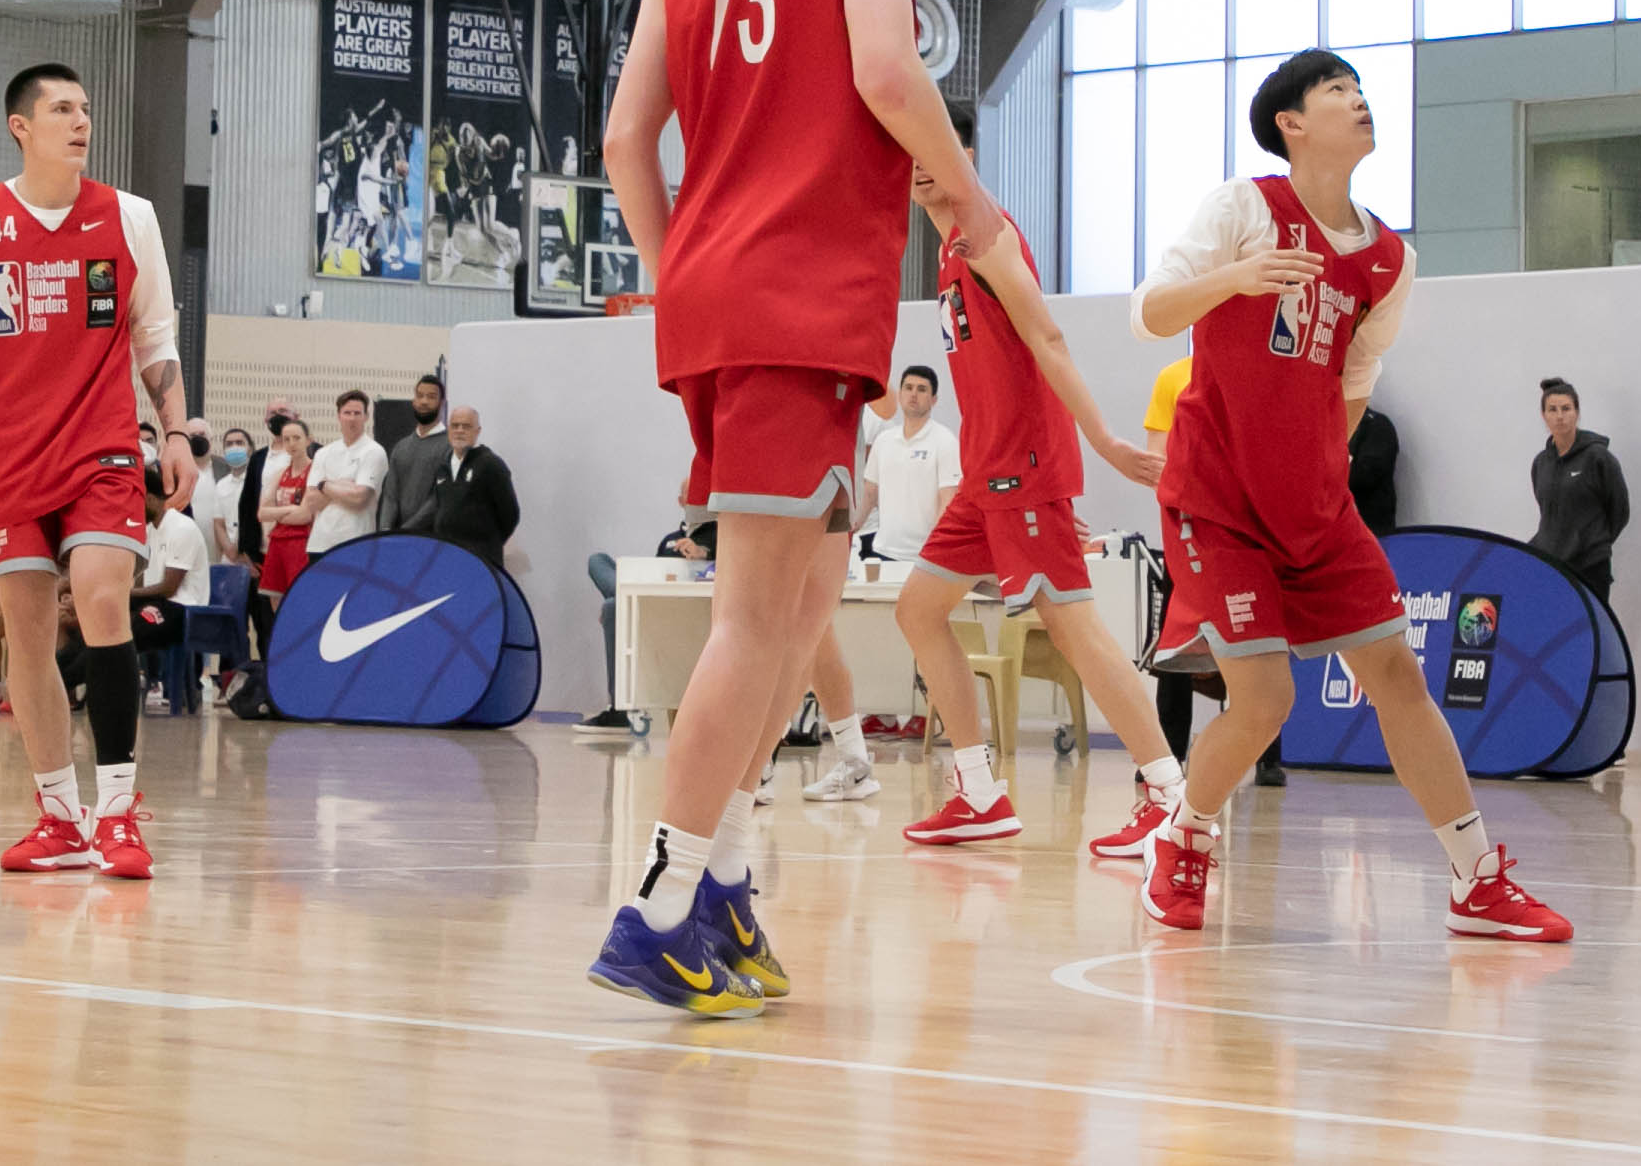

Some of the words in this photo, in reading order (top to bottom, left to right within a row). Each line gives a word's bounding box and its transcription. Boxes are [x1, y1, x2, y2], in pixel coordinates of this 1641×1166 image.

[334, 13, 412, 40] PLAYERS
[449, 11, 523, 32] AUSTRALIN
[335, 34, 363, 51] ARE
[365, 37, 411, 56] GREAT
[447, 46, 494, 63] COMPETE
[334, 51, 412, 74] DEFENDERS
[446, 75, 522, 97] PERSISTENCE
[25, 259, 80, 280] Basketball
[27, 278, 66, 297] Without
[28, 296, 68, 315] Borders
[91, 297, 114, 312] FIBA
[28, 315, 47, 332] Asia
[1274, 334, 1293, 350] NBA
[1308, 342, 1330, 368] Asia
[1401, 591, 1451, 621] ketball
[1454, 659, 1486, 680] FIBA
[1328, 680, 1347, 699] NBA
